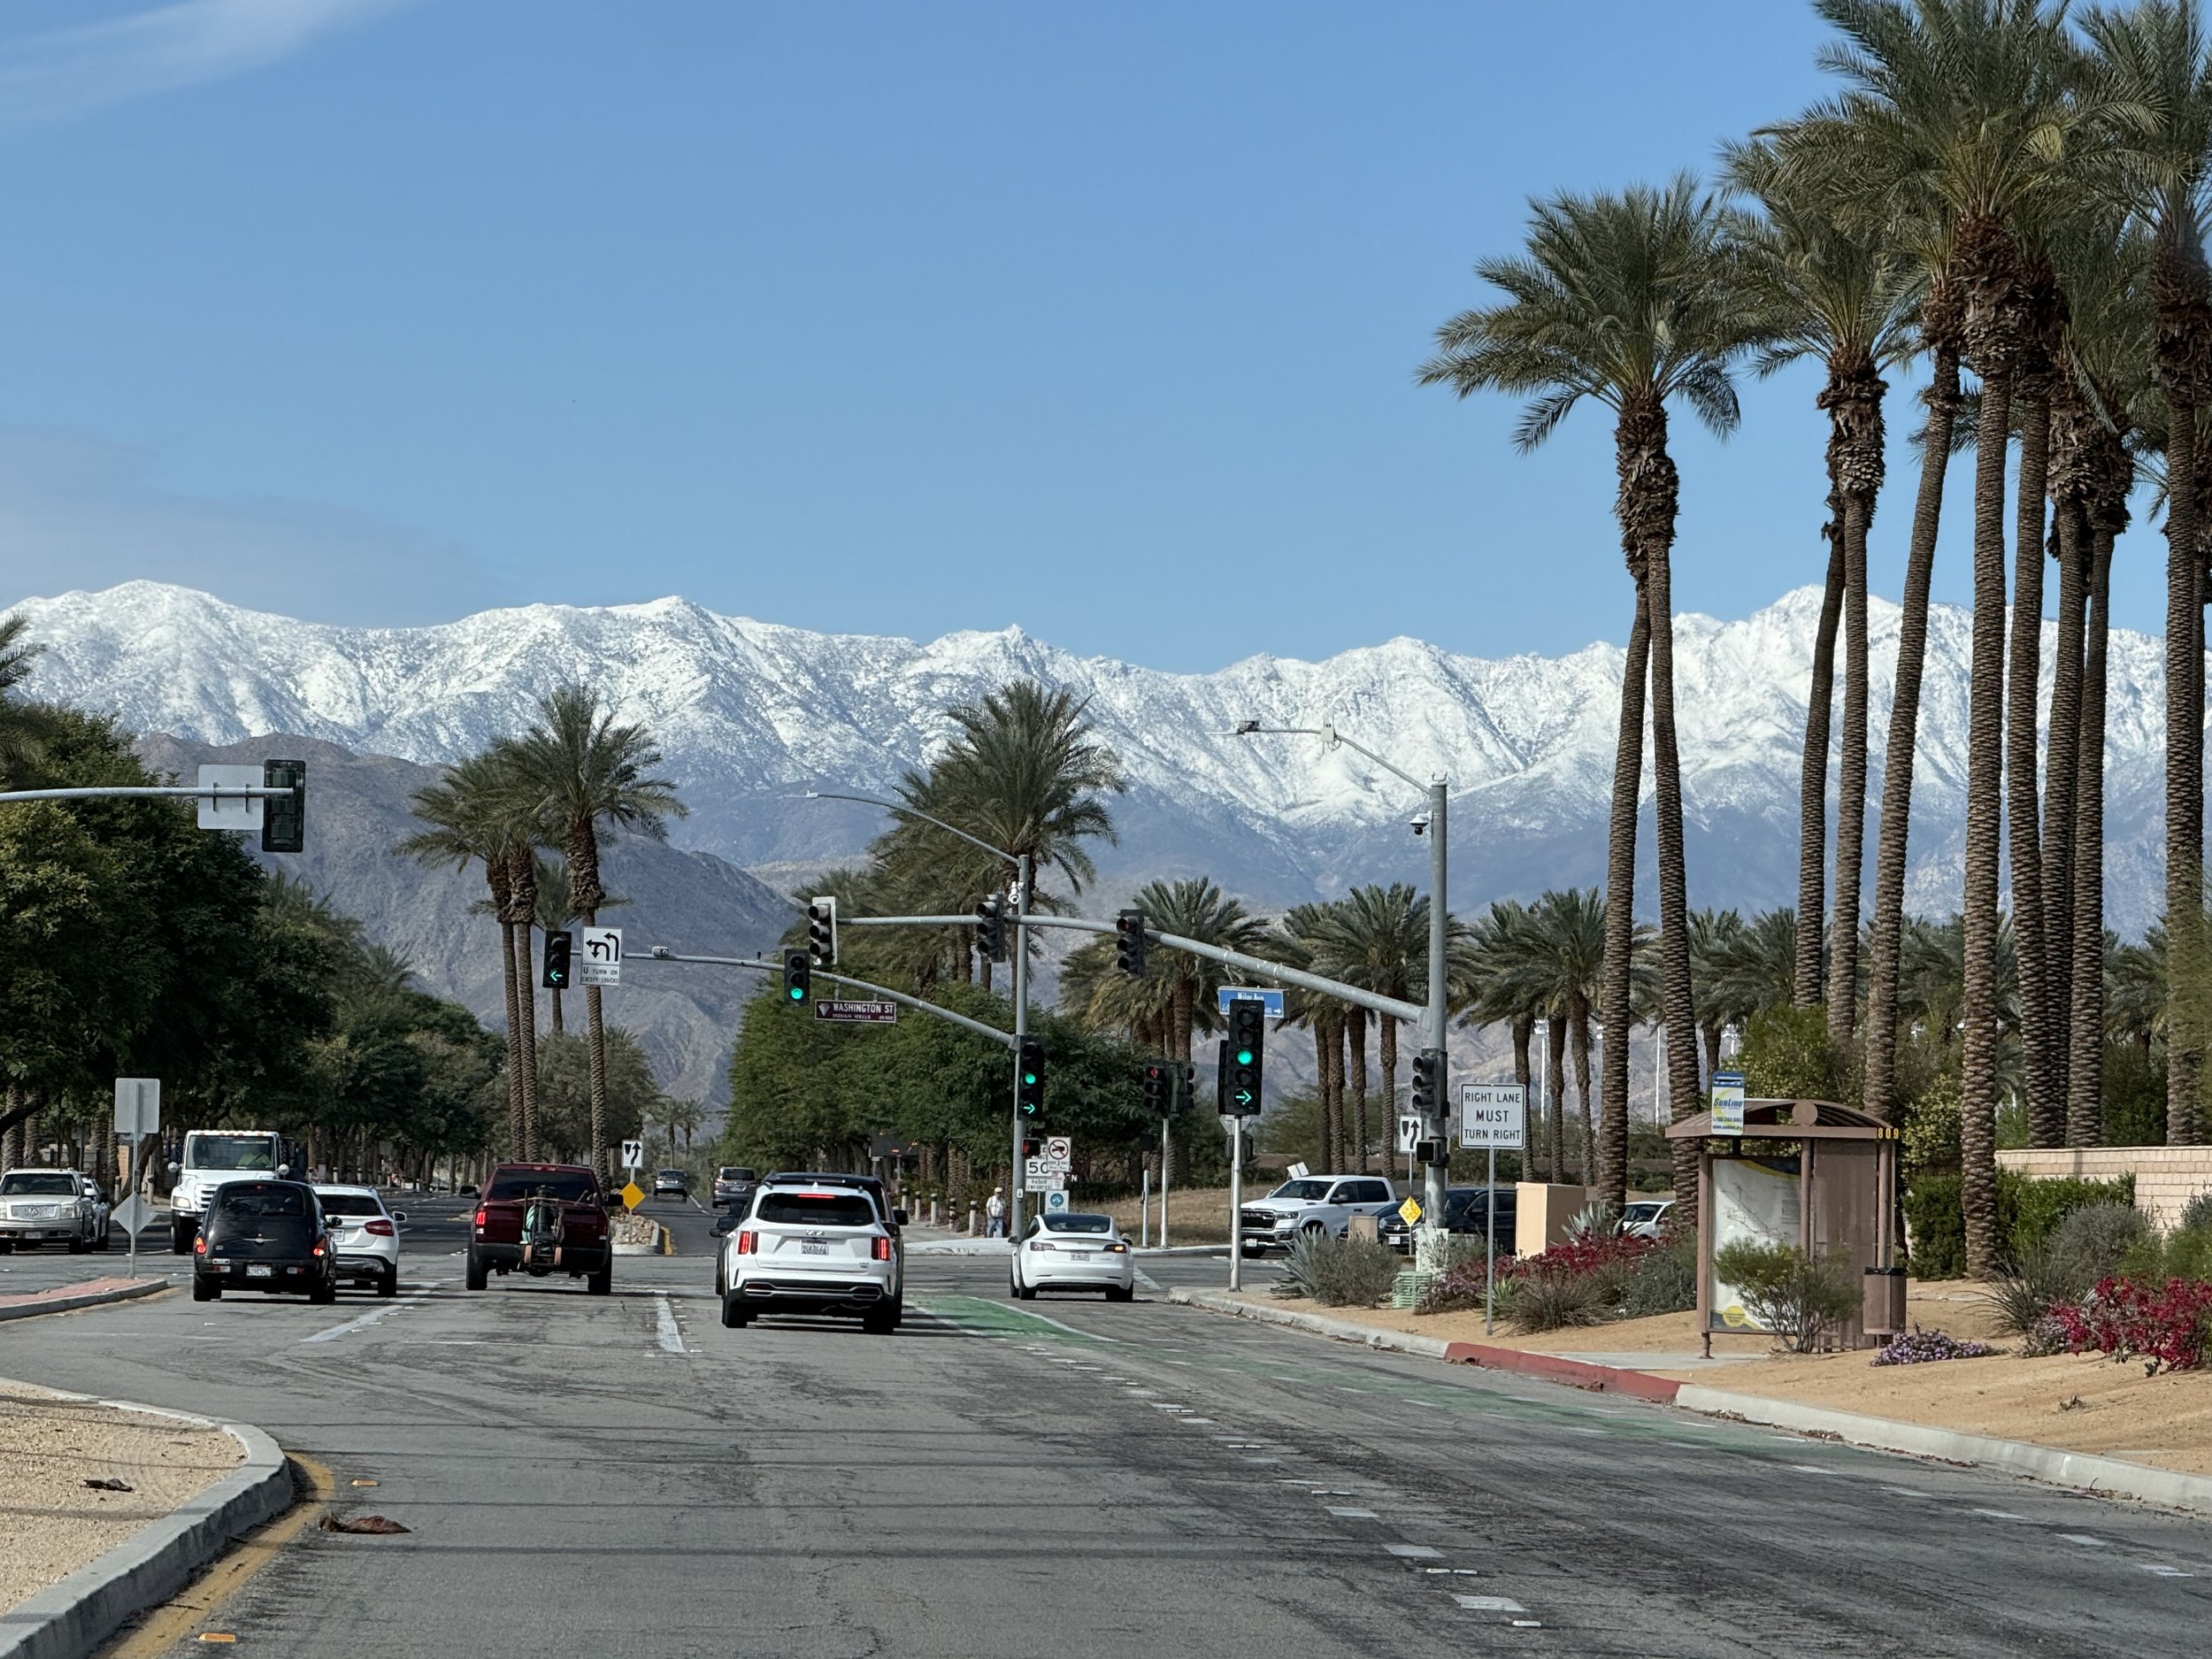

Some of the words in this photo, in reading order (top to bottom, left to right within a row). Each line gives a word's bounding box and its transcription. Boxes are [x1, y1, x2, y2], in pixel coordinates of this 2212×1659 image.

[833, 1002, 881, 1013] WASHINGTON
[885, 1004, 894, 1014] ST
[1464, 1092, 1492, 1102] RIGHT
[1496, 1093, 1521, 1103] LANE
[1476, 1110, 1509, 1122] MUST
[1464, 1129, 1488, 1140] TURN
[1494, 1130, 1521, 1140] RIGHT
[1878, 1127, 1899, 1139] 809
[1028, 1162, 1049, 1174] 50
